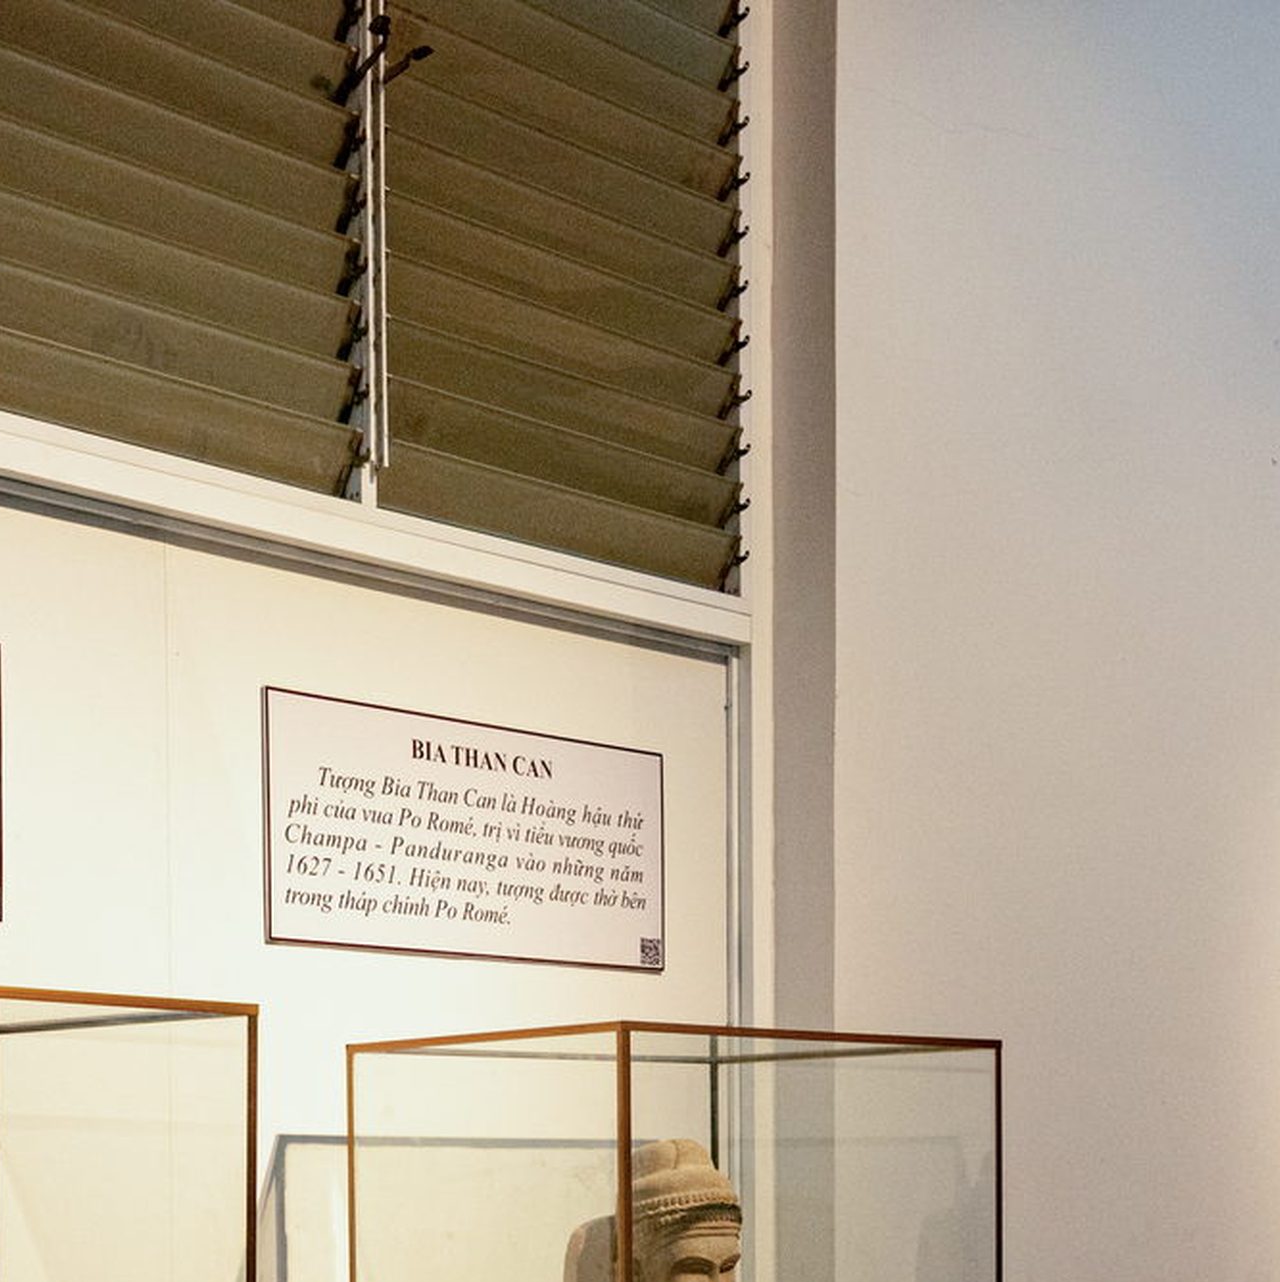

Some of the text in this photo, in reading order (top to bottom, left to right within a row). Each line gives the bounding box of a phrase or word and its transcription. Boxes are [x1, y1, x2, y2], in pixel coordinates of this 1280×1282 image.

[411, 739, 552, 779] BIA THAN CAN
[288, 794, 318, 818] phi
[362, 808, 393, 825] vua
[398, 808, 422, 828] Po
[426, 811, 477, 838] Romé,
[482, 821, 502, 843] trị
[558, 834, 605, 857] vương
[319, 766, 376, 798] Tượng
[381, 776, 411, 798] Bia
[417, 780, 458, 805] Than
[463, 788, 497, 810] Can
[581, 804, 612, 828] hậu
[284, 823, 367, 855] Champa
[390, 836, 508, 872] Panduranga
[552, 856, 605, 884] những
[287, 854, 332, 876] 1627
[354, 861, 401, 885] 1651.
[409, 867, 451, 893] Hiện
[456, 878, 489, 899] nay,
[496, 881, 544, 905] tượng
[549, 883, 589, 907] được
[285, 888, 510, 925] trong tháp chính Po Romé.
